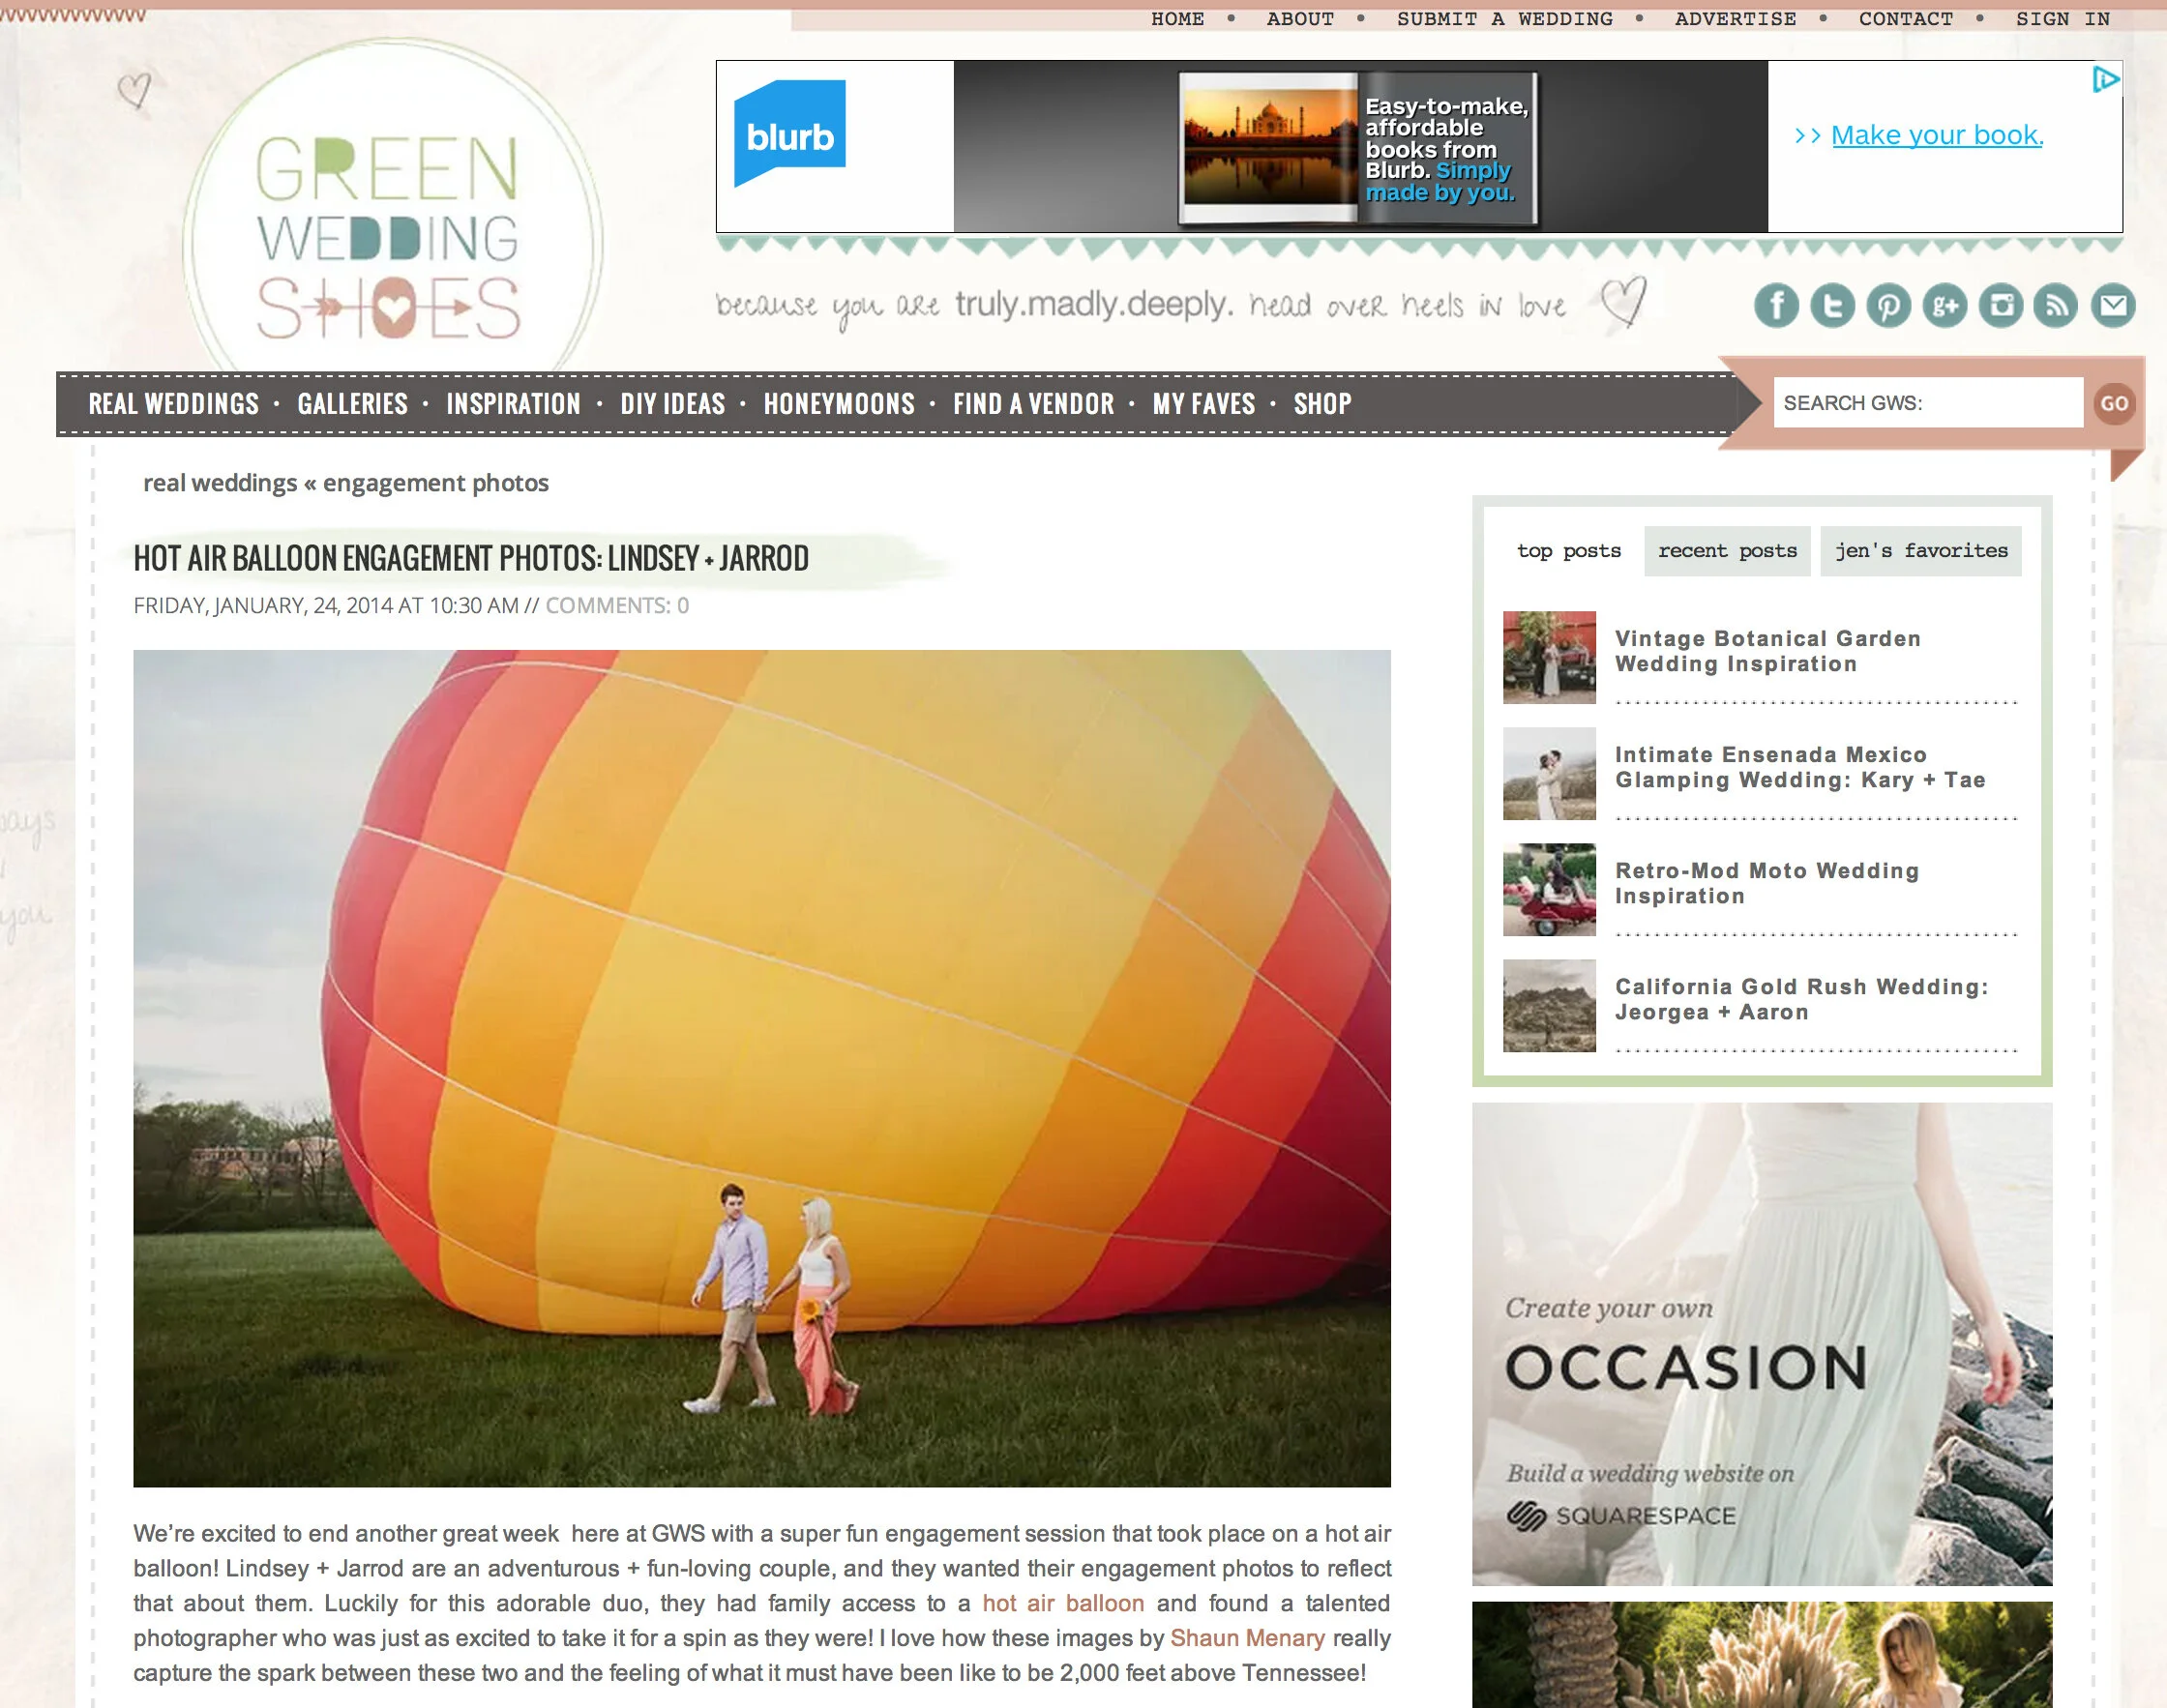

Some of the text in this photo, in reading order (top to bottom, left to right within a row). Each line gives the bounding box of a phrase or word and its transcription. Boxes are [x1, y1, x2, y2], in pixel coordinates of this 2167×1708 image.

[1151, 11, 1204, 26] HOME
[1266, 11, 1334, 26] ABOUT
[1397, 11, 1614, 26] SUBMIT A WEDDING
[1675, 11, 1796, 26] ADVERTISE
[1859, 11, 1954, 26] CONTACT
[2016, 11, 2111, 26] SIGN IN
[1365, 96, 1529, 120] Easy-to-make,
[747, 122, 835, 152] blurb
[1365, 117, 1485, 137] affordable
[1832, 123, 2044, 149] Make your book.
[1366, 140, 1499, 160] books from
[256, 135, 517, 201] GREEN
[1366, 160, 1513, 184] Blurb. Simply
[1365, 182, 1516, 206] made by you.
[256, 215, 518, 262] WEDDING
[256, 276, 521, 339] SHOES
[715, 293, 817, 316] because
[833, 297, 884, 335] you
[955, 288, 1233, 323] truly.madly.deeply.
[1249, 292, 1311, 318] head
[1402, 292, 1464, 318] heels
[1520, 293, 1566, 318] love
[89, 392, 259, 416] REAL WEDDINGS
[297, 392, 408, 416] GALLERIES
[447, 392, 580, 416] INSPIRATION
[621, 392, 726, 416] DIY IDEAS
[764, 392, 915, 416] HONEYMOONS
[954, 392, 1114, 416] FIND A VENDOR
[1153, 392, 1256, 416] MY FAVES
[1293, 392, 1352, 416] SHOP
[1784, 395, 1922, 411] SEARCH GWS:
[2100, 395, 2129, 412] GO
[144, 472, 186, 492] real
[191, 472, 298, 498] weddings
[323, 475, 466, 498] engagement
[472, 472, 549, 498] photos
[134, 544, 182, 572] HOT
[187, 544, 227, 572] AIR
[233, 544, 337, 572] BALLOON
[343, 544, 493, 572] ENGAGEMENT
[500, 544, 603, 572] PHOTOS:
[609, 544, 700, 572] LINDSEY
[719, 544, 809, 572] JARROD
[1517, 543, 1622, 562] top posts
[1658, 543, 1798, 562] recent posts
[1835, 542, 2009, 562] jen's favorites
[134, 595, 691, 619] FRIDAY, JANUARY, 24, 2014 AT 10:30 AM // COMMENTS: 0
[1615, 629, 1920, 652] Vintage Botanical Garden
[1615, 655, 1856, 677] Wedding Inspiration
[1616, 746, 1927, 763] Intimate Ensenada Mexico
[1616, 770, 1986, 793] Glamping Wedding: Kary + Tae
[1616, 862, 1919, 884] Retro-Mod Moto Wedding
[1616, 887, 1744, 908] Inspiration
[1616, 977, 1988, 1000] California Gold Rush Wedding:
[1615, 1003, 1808, 1025] Jeorgea + Aaron
[1505, 1296, 1713, 1324] Create your own
[1505, 1343, 1866, 1391] OCCASION
[1505, 1463, 1796, 1488] Build a wedding website on
[1556, 1506, 1737, 1526] SQUARESPACE
[201, 1523, 276, 1543] excited
[282, 1524, 303, 1543] to
[309, 1523, 348, 1543] end
[355, 1523, 438, 1543] another
[442, 1524, 499, 1547] great
[502, 1523, 560, 1543] week
[572, 1523, 620, 1543] here
[626, 1524, 647, 1543] at
[651, 1523, 706, 1543] GWS
[711, 1523, 754, 1543] with
[760, 1528, 774, 1543] a
[780, 1528, 842, 1547] super
[846, 1523, 878, 1543] fun
[885, 1524, 1021, 1547] engagement
[1024, 1523, 1106, 1543] session
[1112, 1523, 1153, 1543] that
[1156, 1523, 1202, 1543] took
[1208, 1523, 1265, 1547] place
[1271, 1528, 1298, 1543] on
[1305, 1528, 1319, 1543] a
[1325, 1523, 1360, 1543] hot
[1364, 1523, 1393, 1543] air
[1171, 1628, 1326, 1652] Shaun Menary
[842, 1663, 1366, 1685] have been like to be 2,000 feet above Tennessee!
